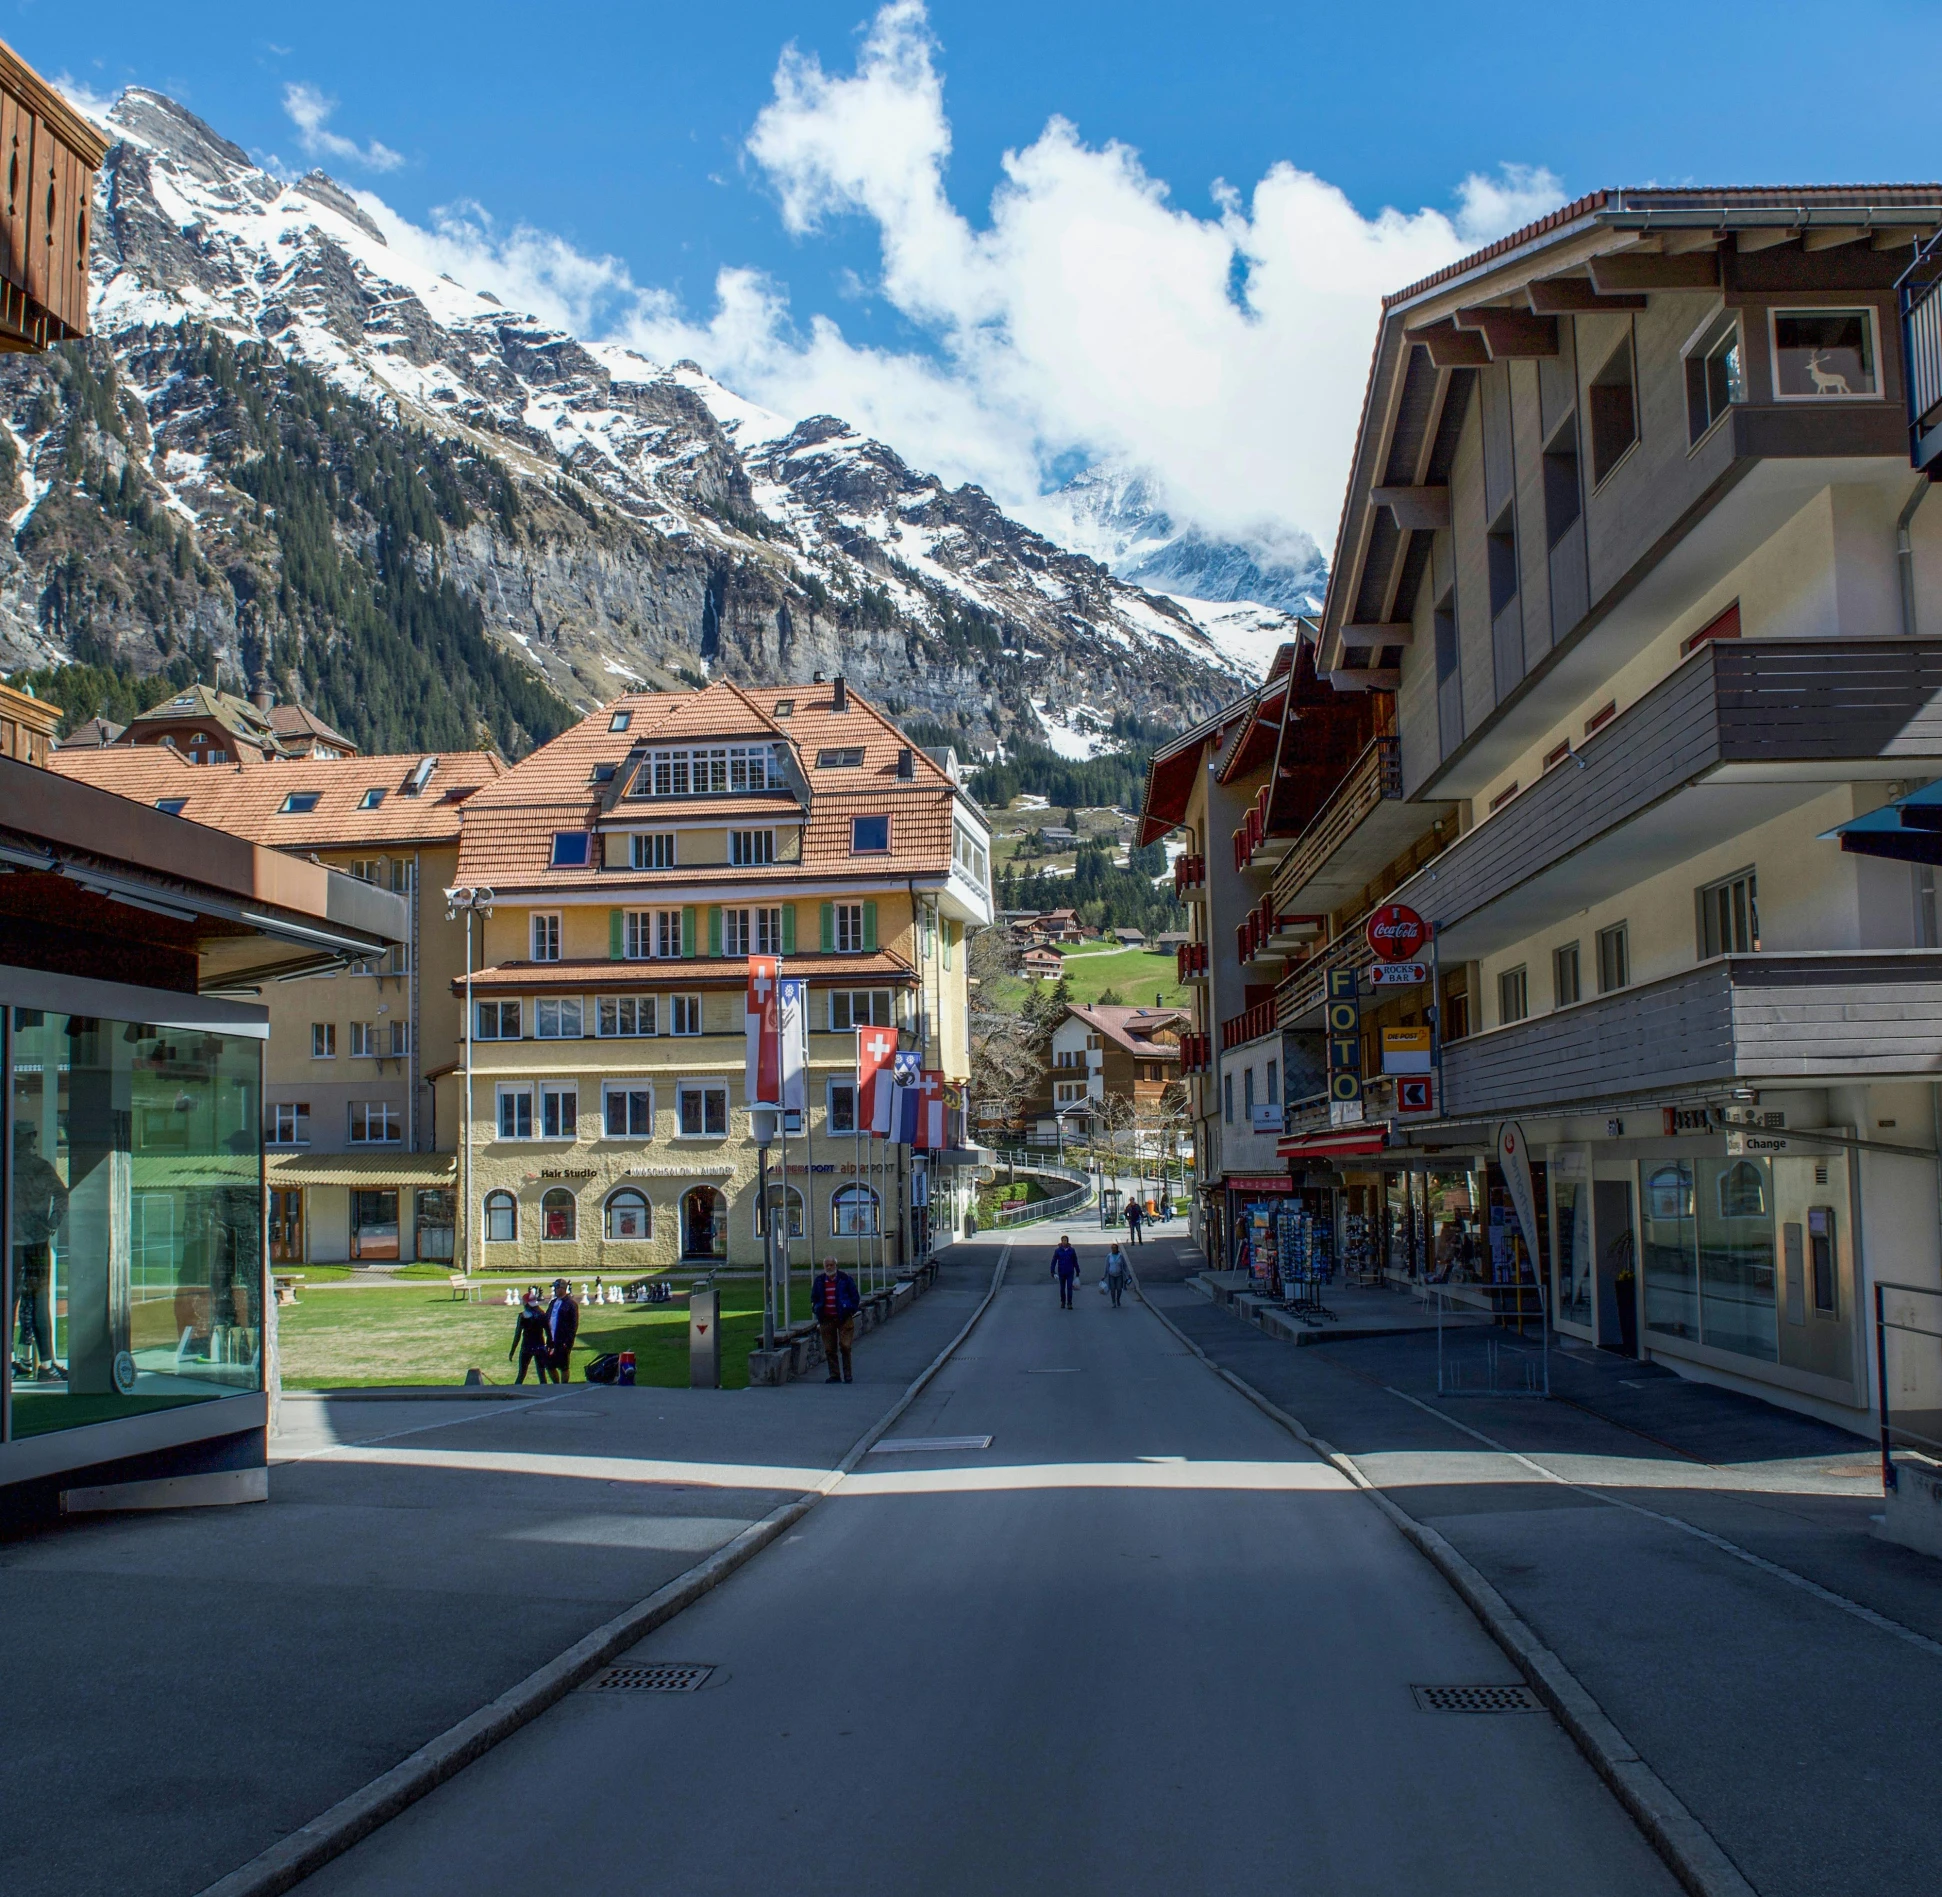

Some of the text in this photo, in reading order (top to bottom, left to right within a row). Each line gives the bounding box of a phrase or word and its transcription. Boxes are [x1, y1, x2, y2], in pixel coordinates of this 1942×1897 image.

[1373, 922, 1419, 938] Coca-Cola
[1383, 965, 1415, 974] ROCKS
[1389, 974, 1410, 982] BAR
[1331, 970, 1359, 1100] FOTO
[1746, 1138, 1787, 1151] Change
[541, 1168, 598, 1178] Hair Studio
[631, 1165, 736, 1177] WASCHSALON LAUNDRY
